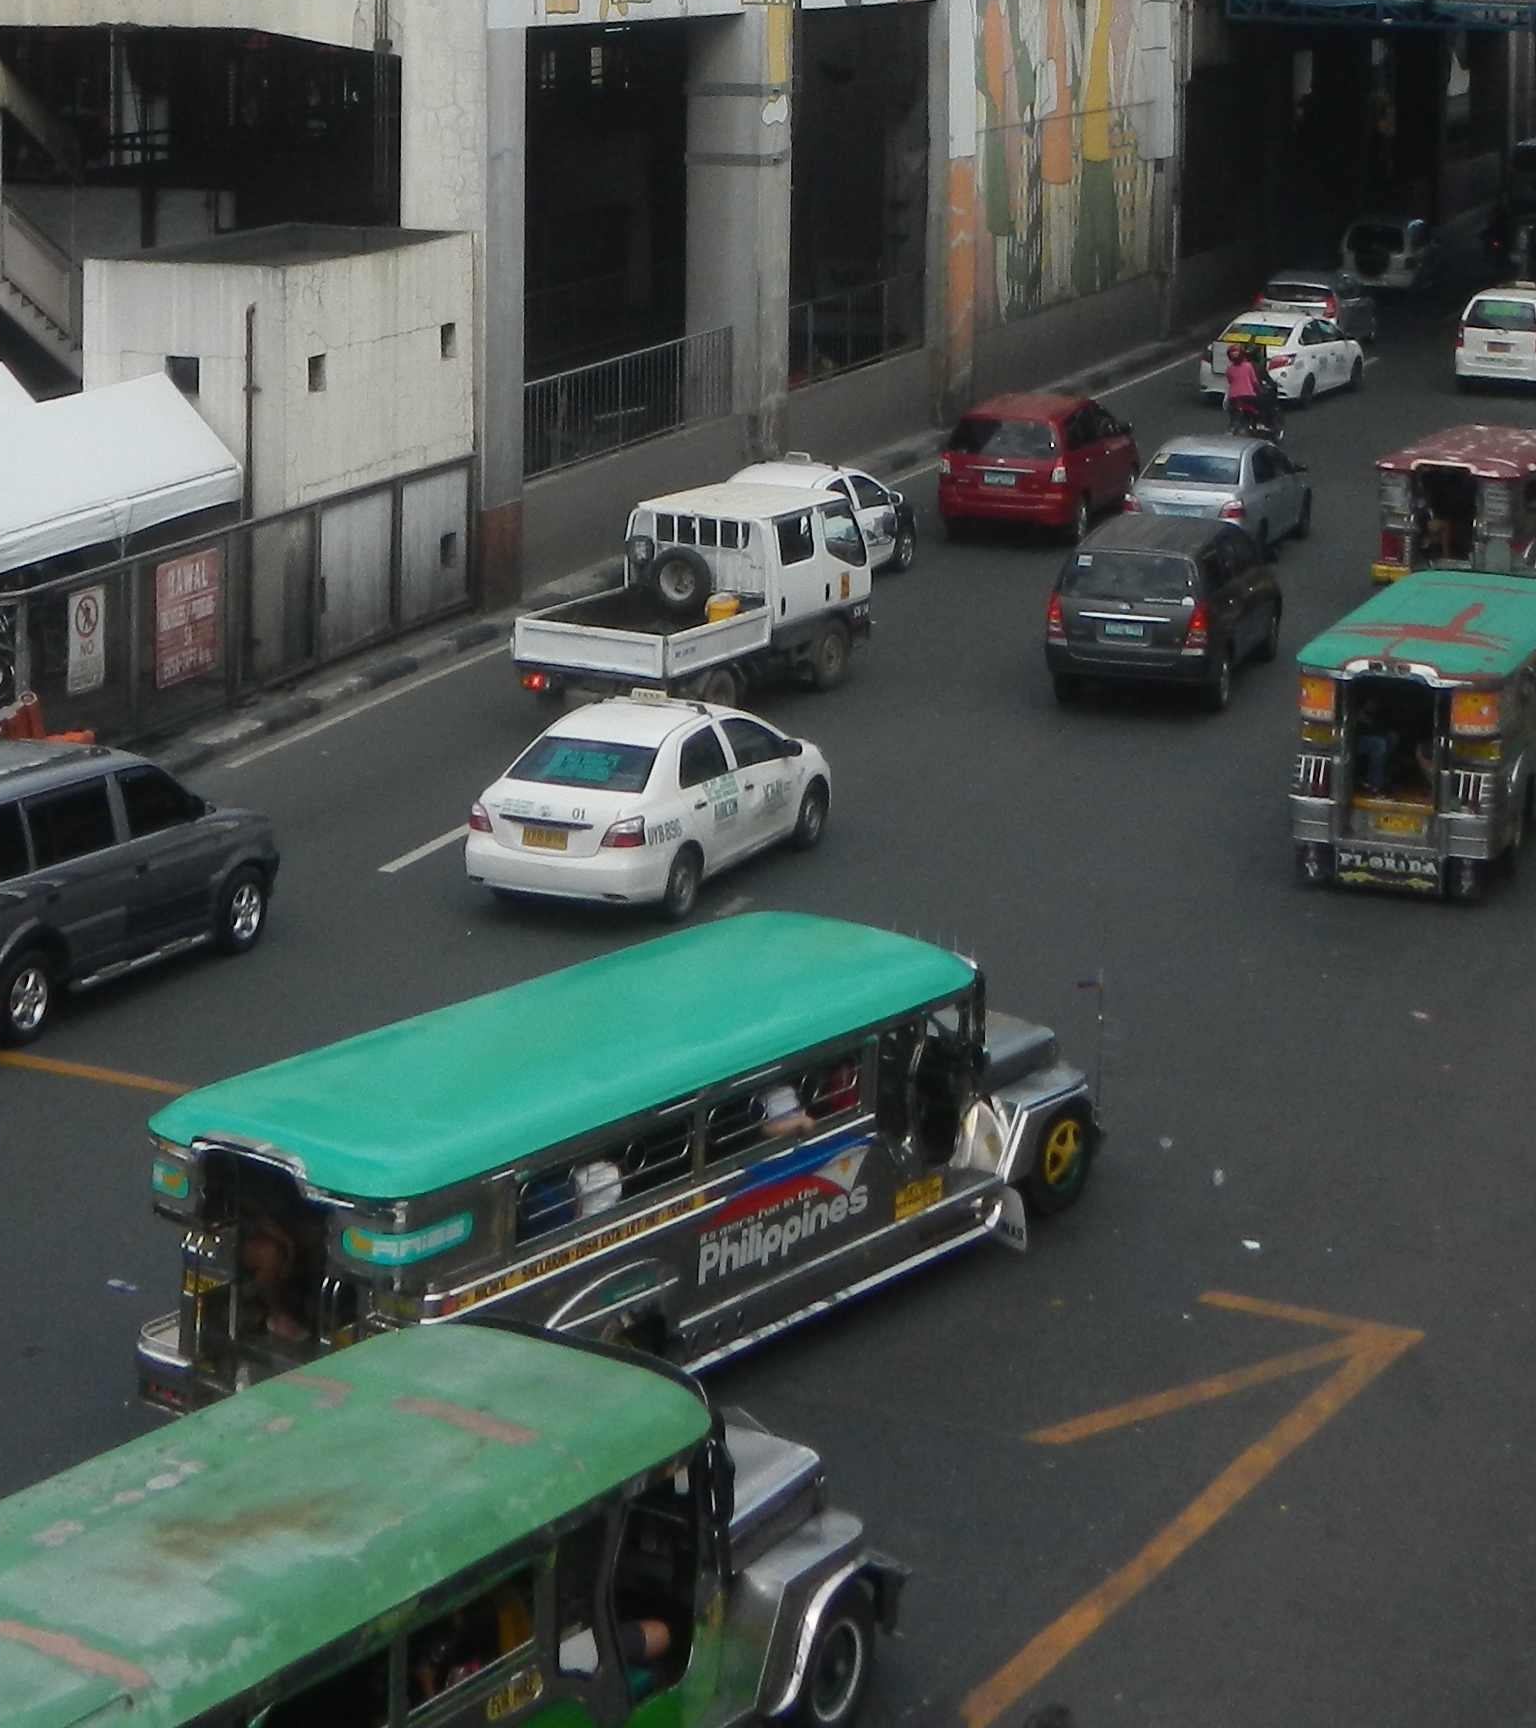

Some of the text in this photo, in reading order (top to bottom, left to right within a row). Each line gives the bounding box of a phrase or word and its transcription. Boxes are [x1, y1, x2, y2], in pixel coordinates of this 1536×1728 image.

[79, 639, 95, 657] NO
[571, 807, 586, 820] 01
[697, 1184, 869, 1286] Philippines
